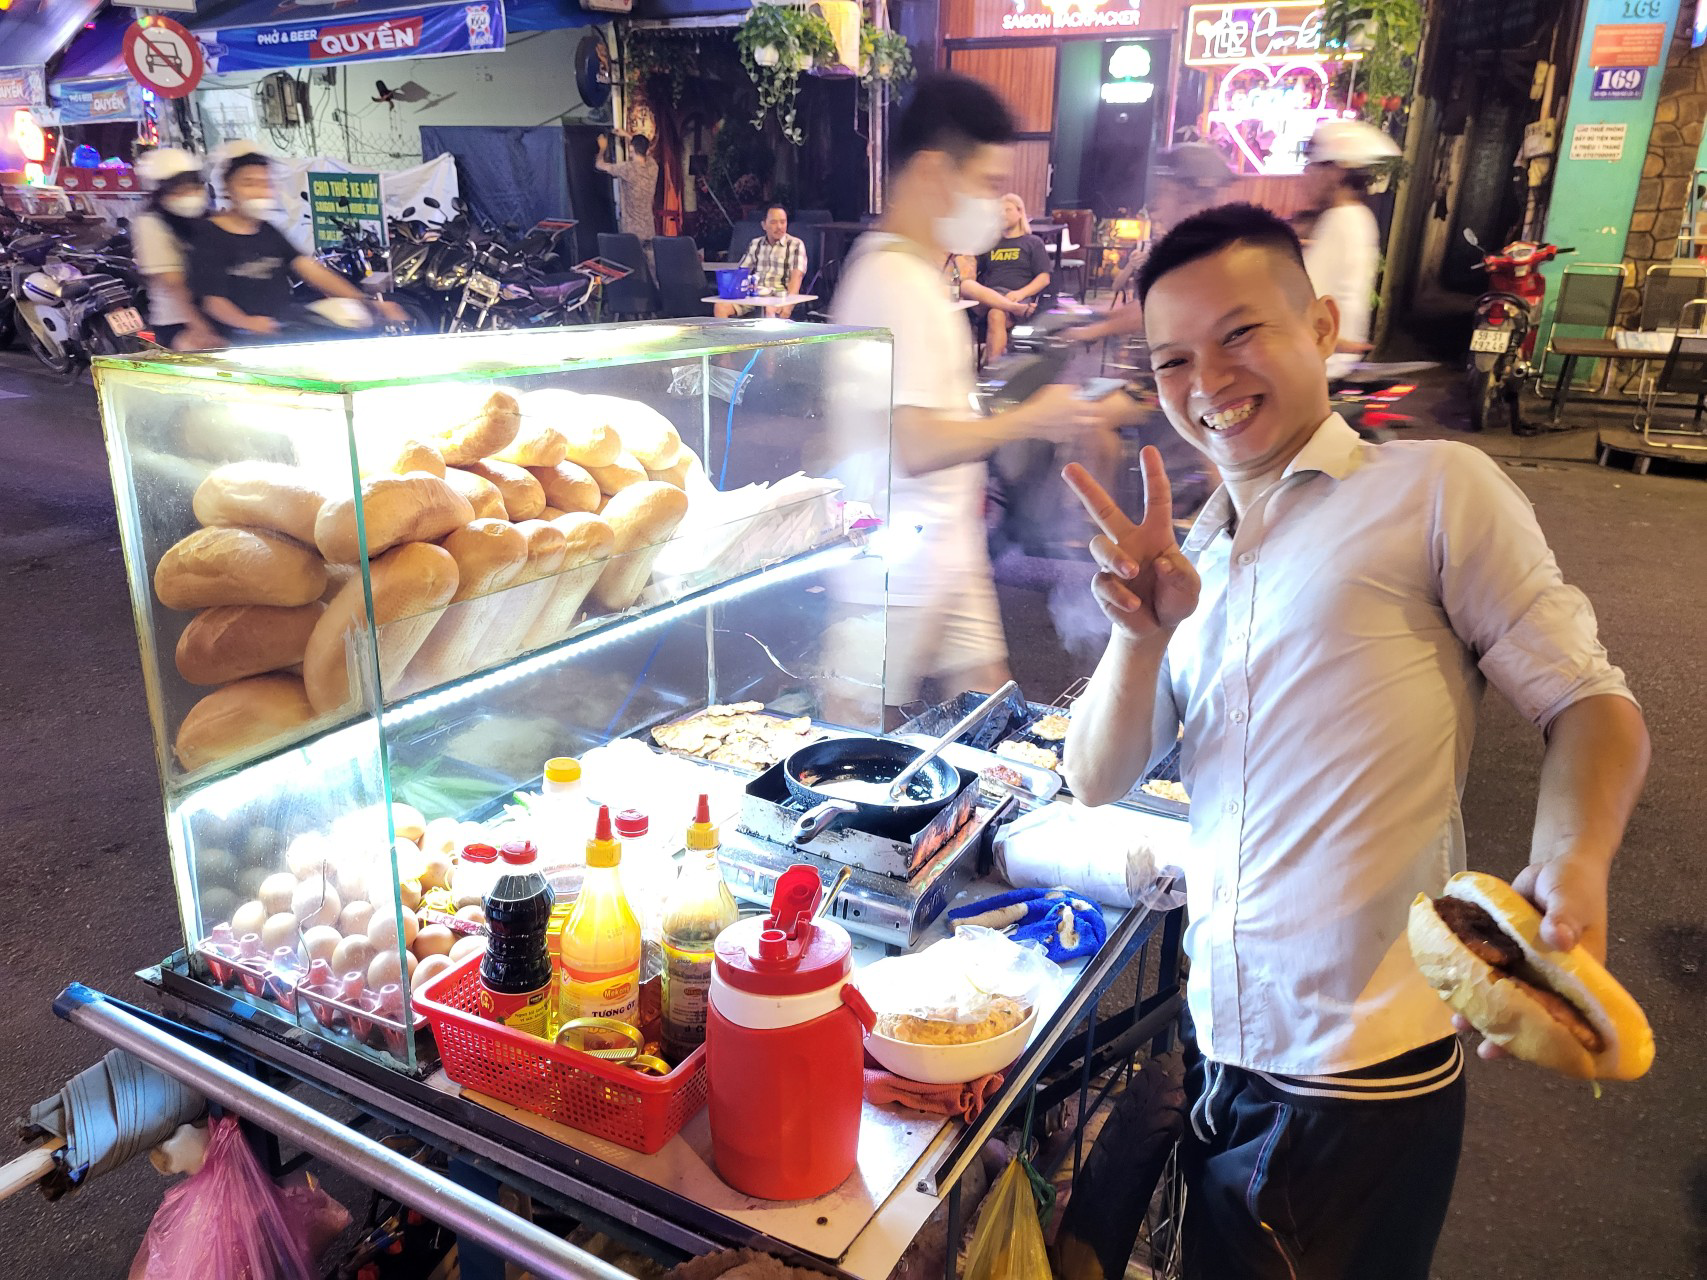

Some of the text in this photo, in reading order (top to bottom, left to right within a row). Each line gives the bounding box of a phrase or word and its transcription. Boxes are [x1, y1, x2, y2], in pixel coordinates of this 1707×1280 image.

[1001, 10, 1140, 30] SAIGON BACKPACKER
[281, 32, 289, 44] &
[290, 29, 318, 42] BEER
[320, 21, 414, 55] QUYỀN
[1599, 69, 1641, 90] 169
[313, 177, 378, 199] CHO THUÊ XE MÁY
[990, 247, 1021, 261] VANS
[592, 1007, 625, 1018] TƯƠNG
